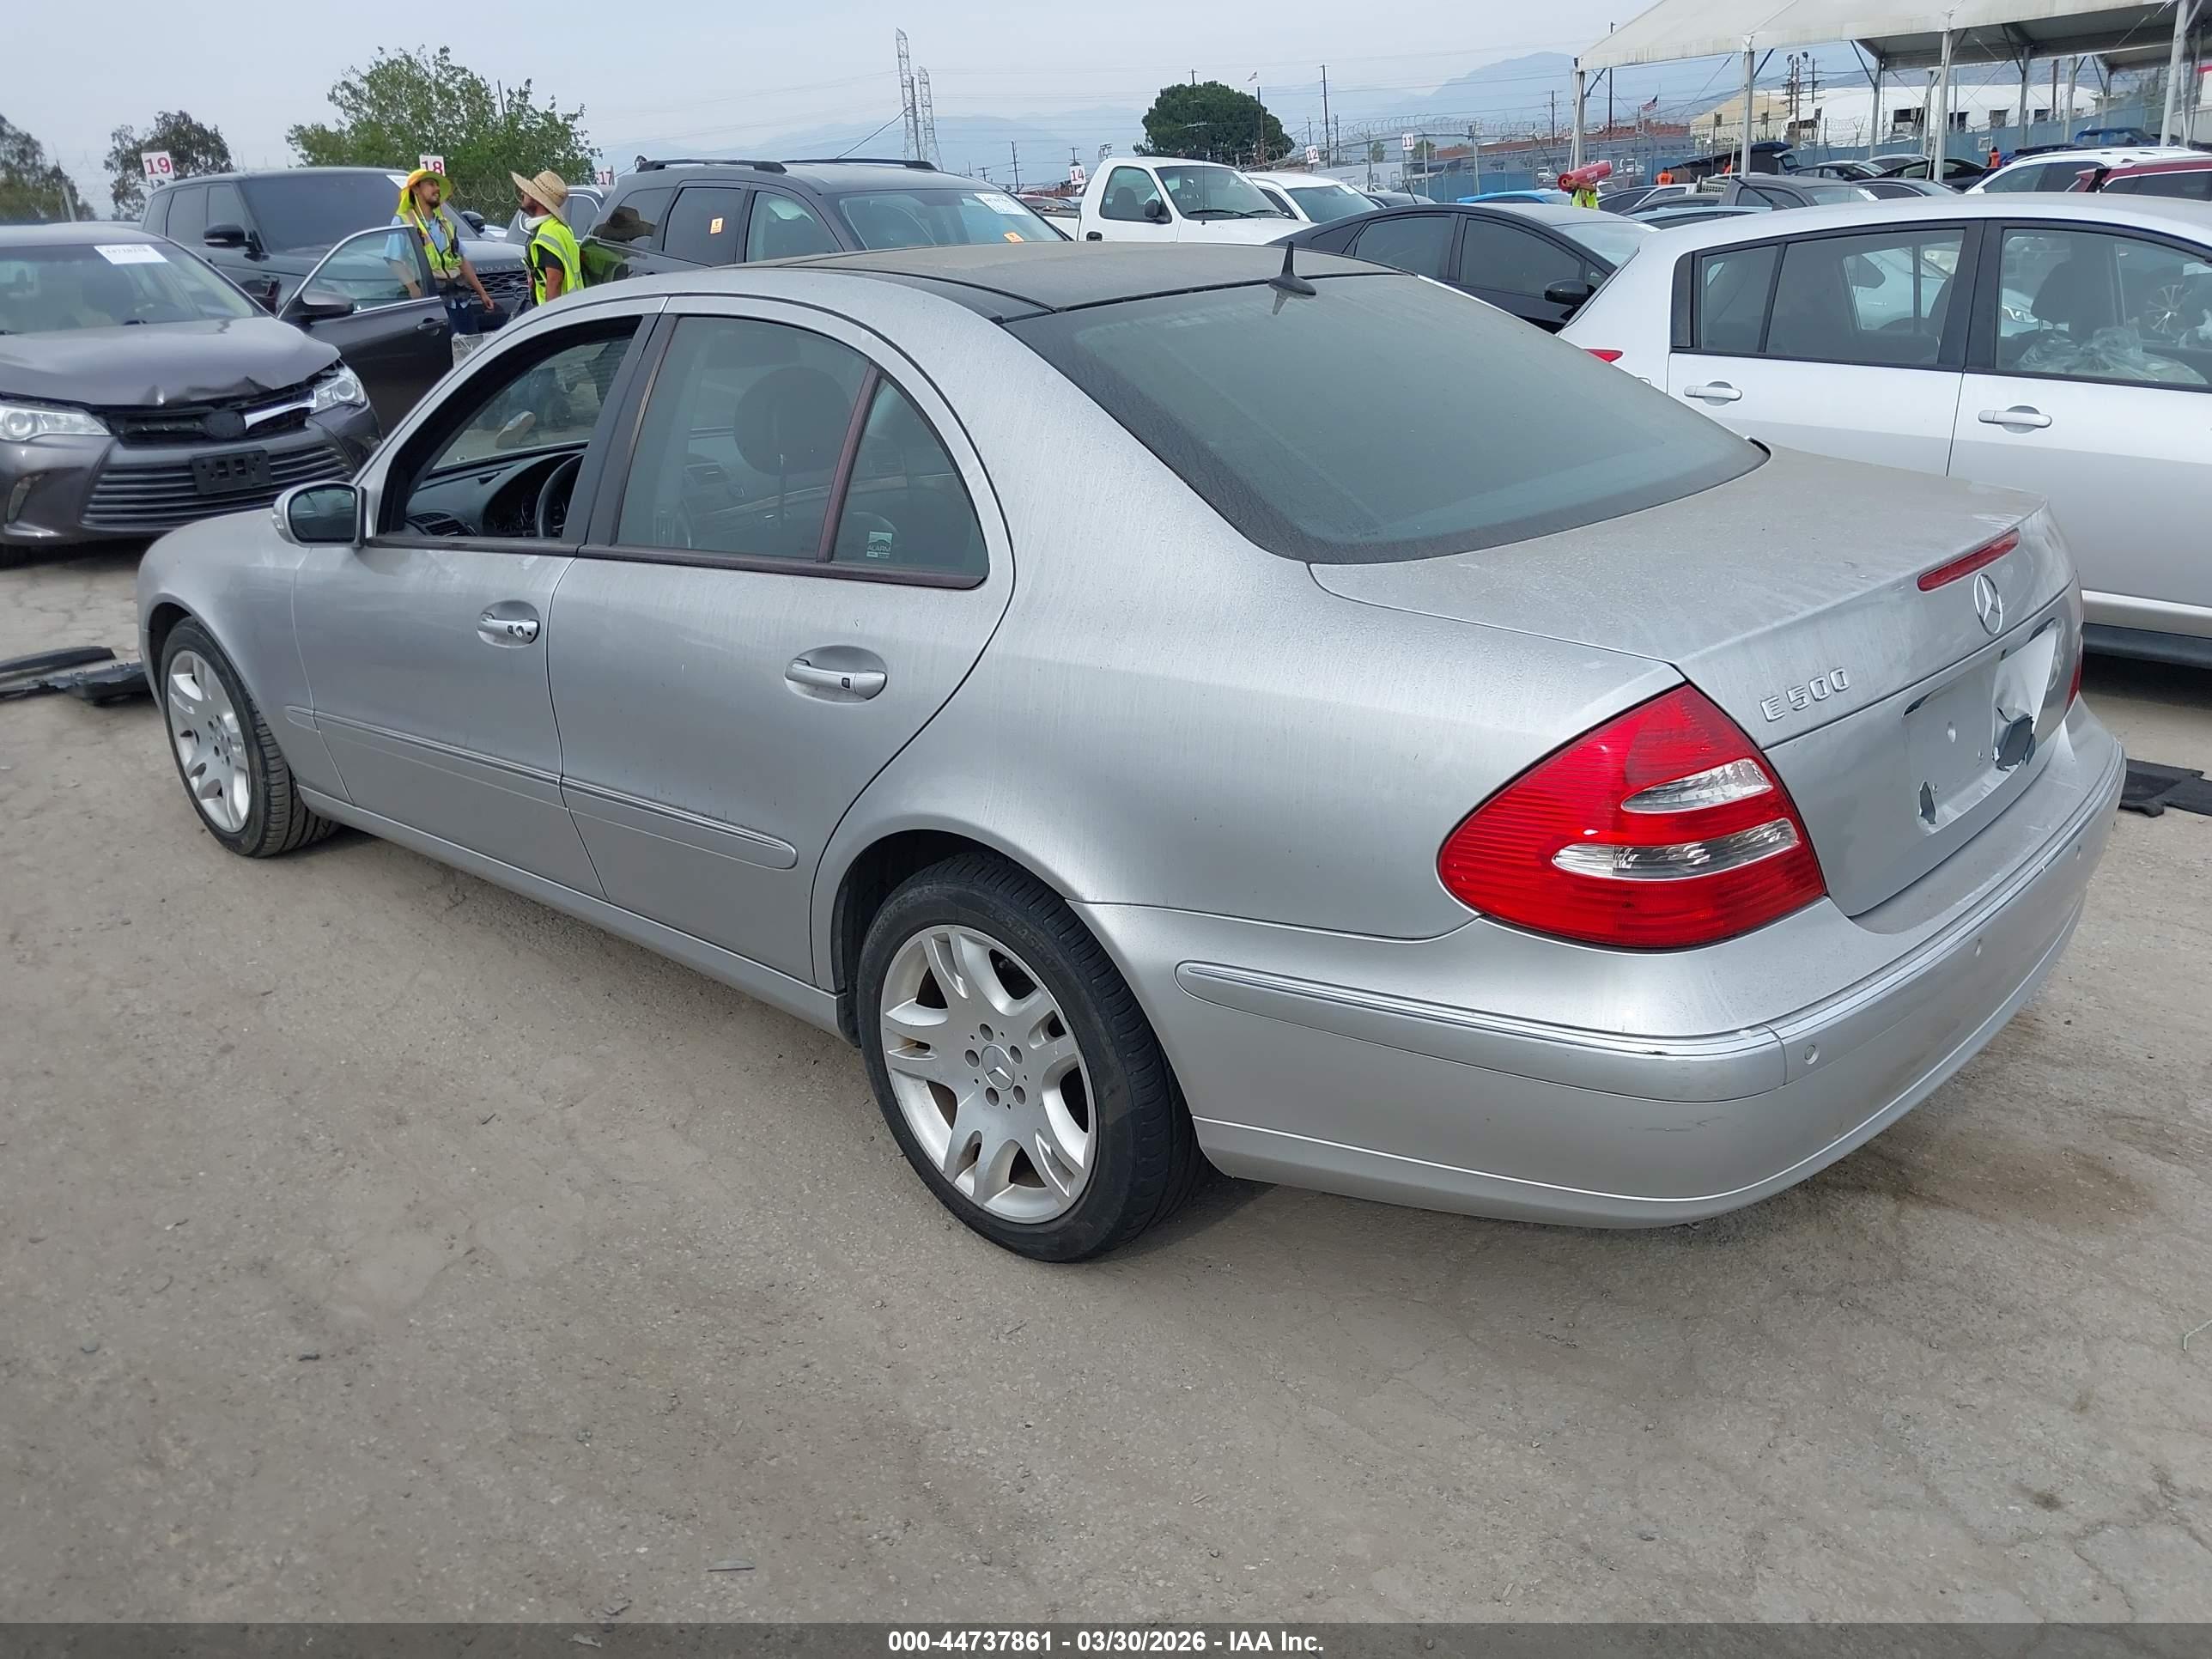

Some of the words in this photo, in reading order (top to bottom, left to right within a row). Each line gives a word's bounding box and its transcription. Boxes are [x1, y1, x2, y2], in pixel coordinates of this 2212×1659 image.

[1564, 127, 1572, 137] 10
[1403, 137, 1413, 147] 11
[1307, 149, 1318, 161] 12
[144, 156, 171, 175] 19
[422, 161, 443, 176] 18
[599, 171, 612, 186] 17
[1071, 168, 1085, 181] 14
[1760, 694, 1786, 723] E
[1786, 666, 1850, 712] 500
